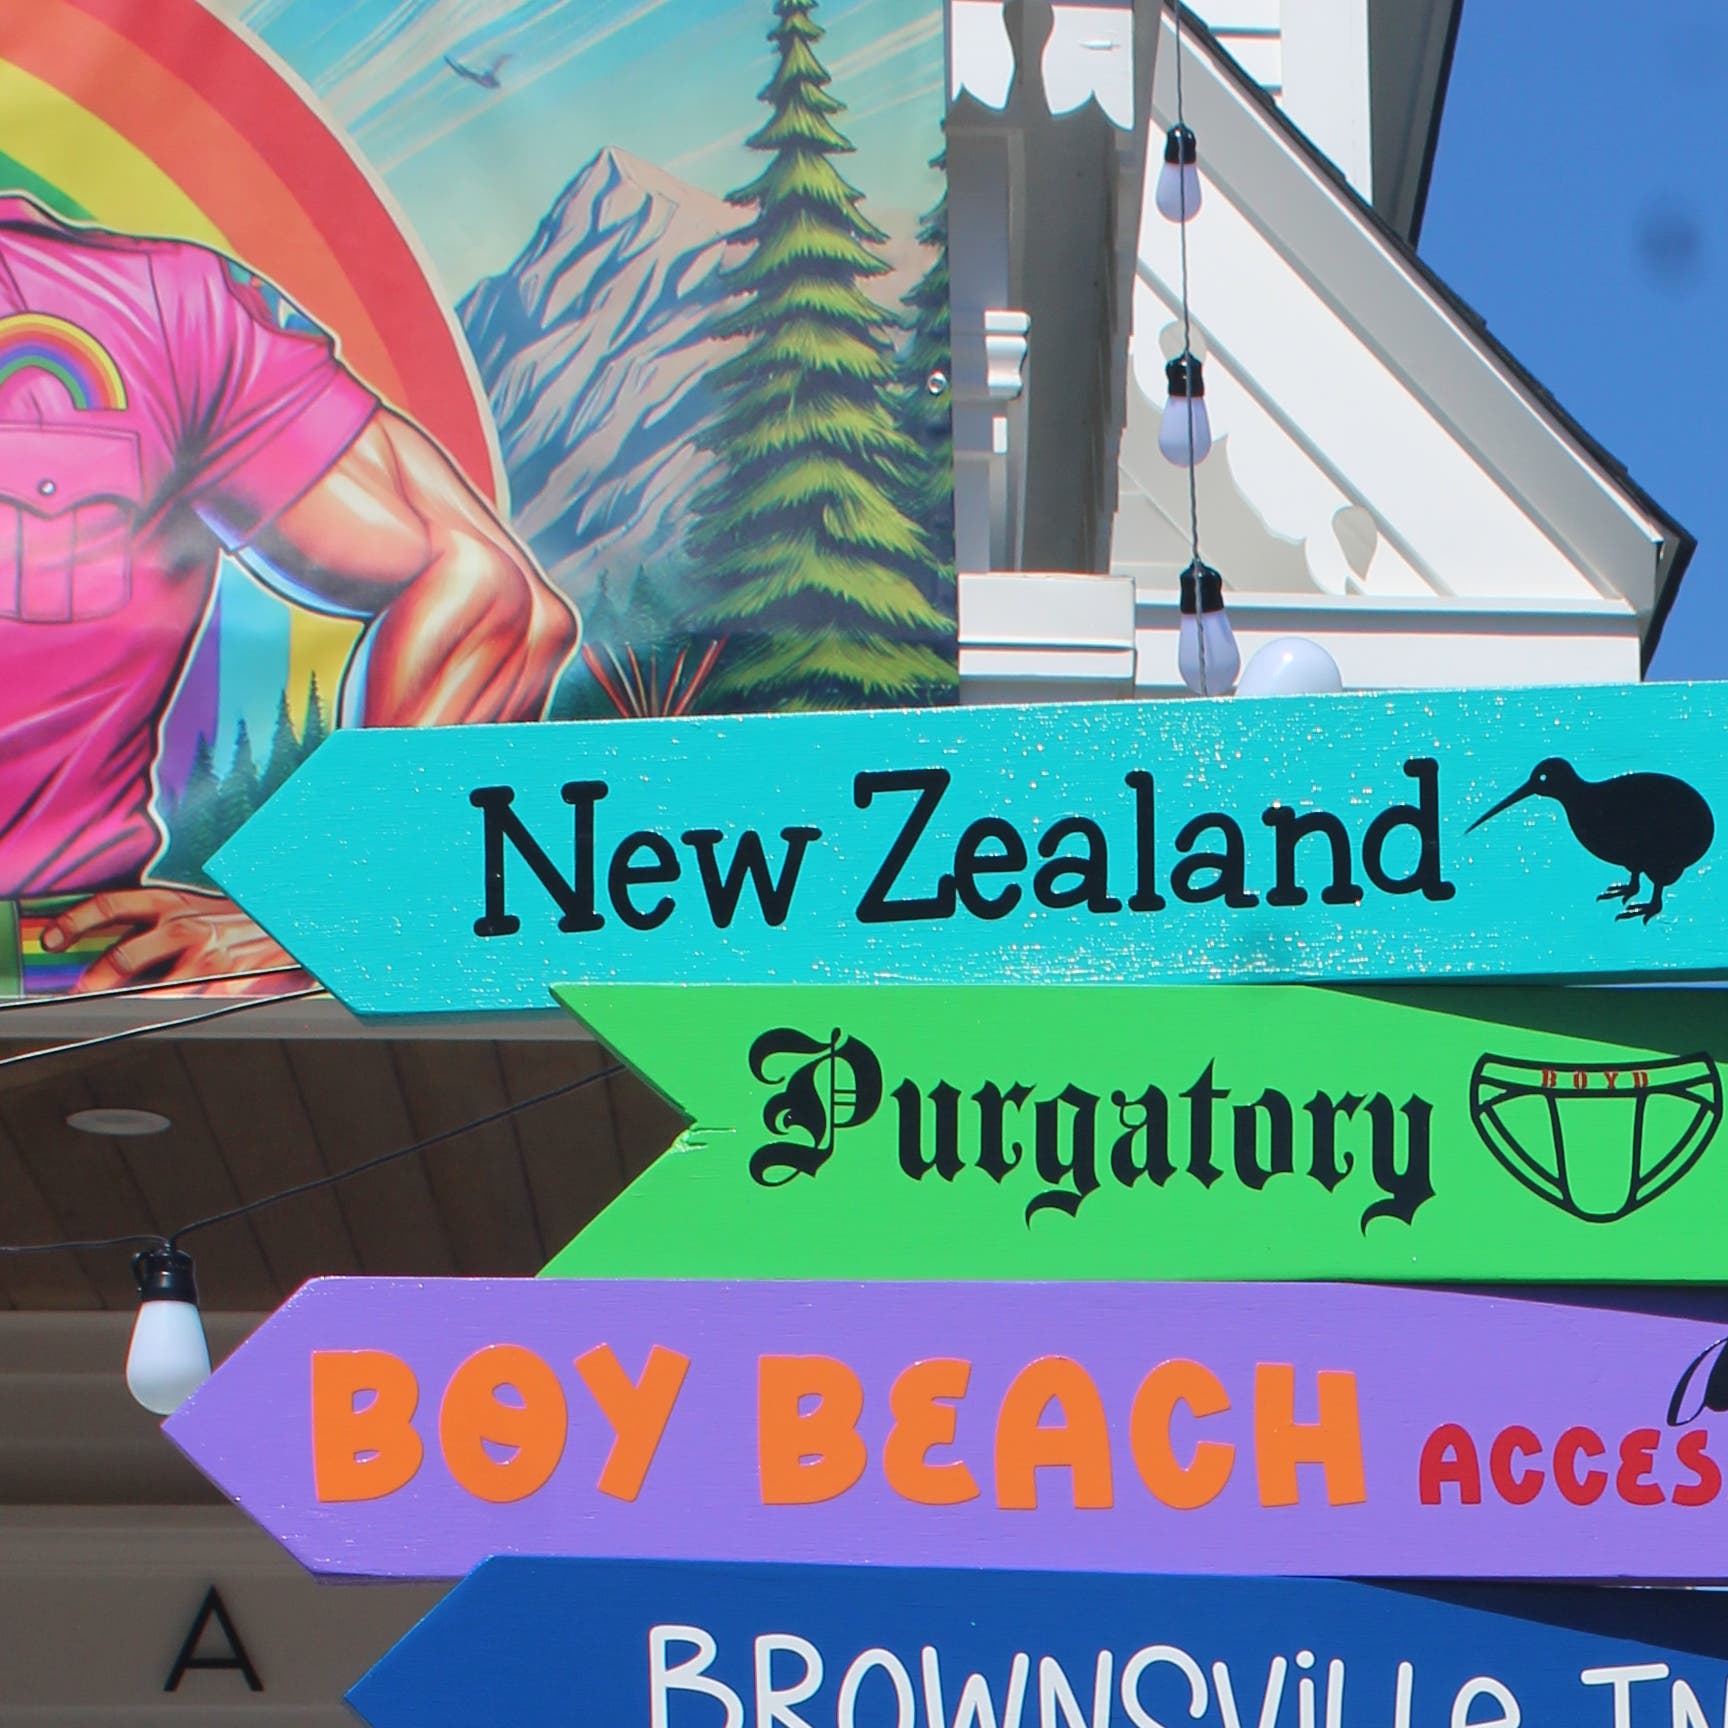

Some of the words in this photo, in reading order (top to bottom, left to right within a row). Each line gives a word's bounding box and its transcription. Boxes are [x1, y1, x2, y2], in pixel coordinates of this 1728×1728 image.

[470, 780, 821, 937] New
[853, 757, 1457, 924] Zealand
[747, 1026, 1437, 1238] Purgatory
[310, 1343, 691, 1503] BOY
[758, 1354, 1368, 1511] BEACH
[163, 1585, 265, 1692] A
